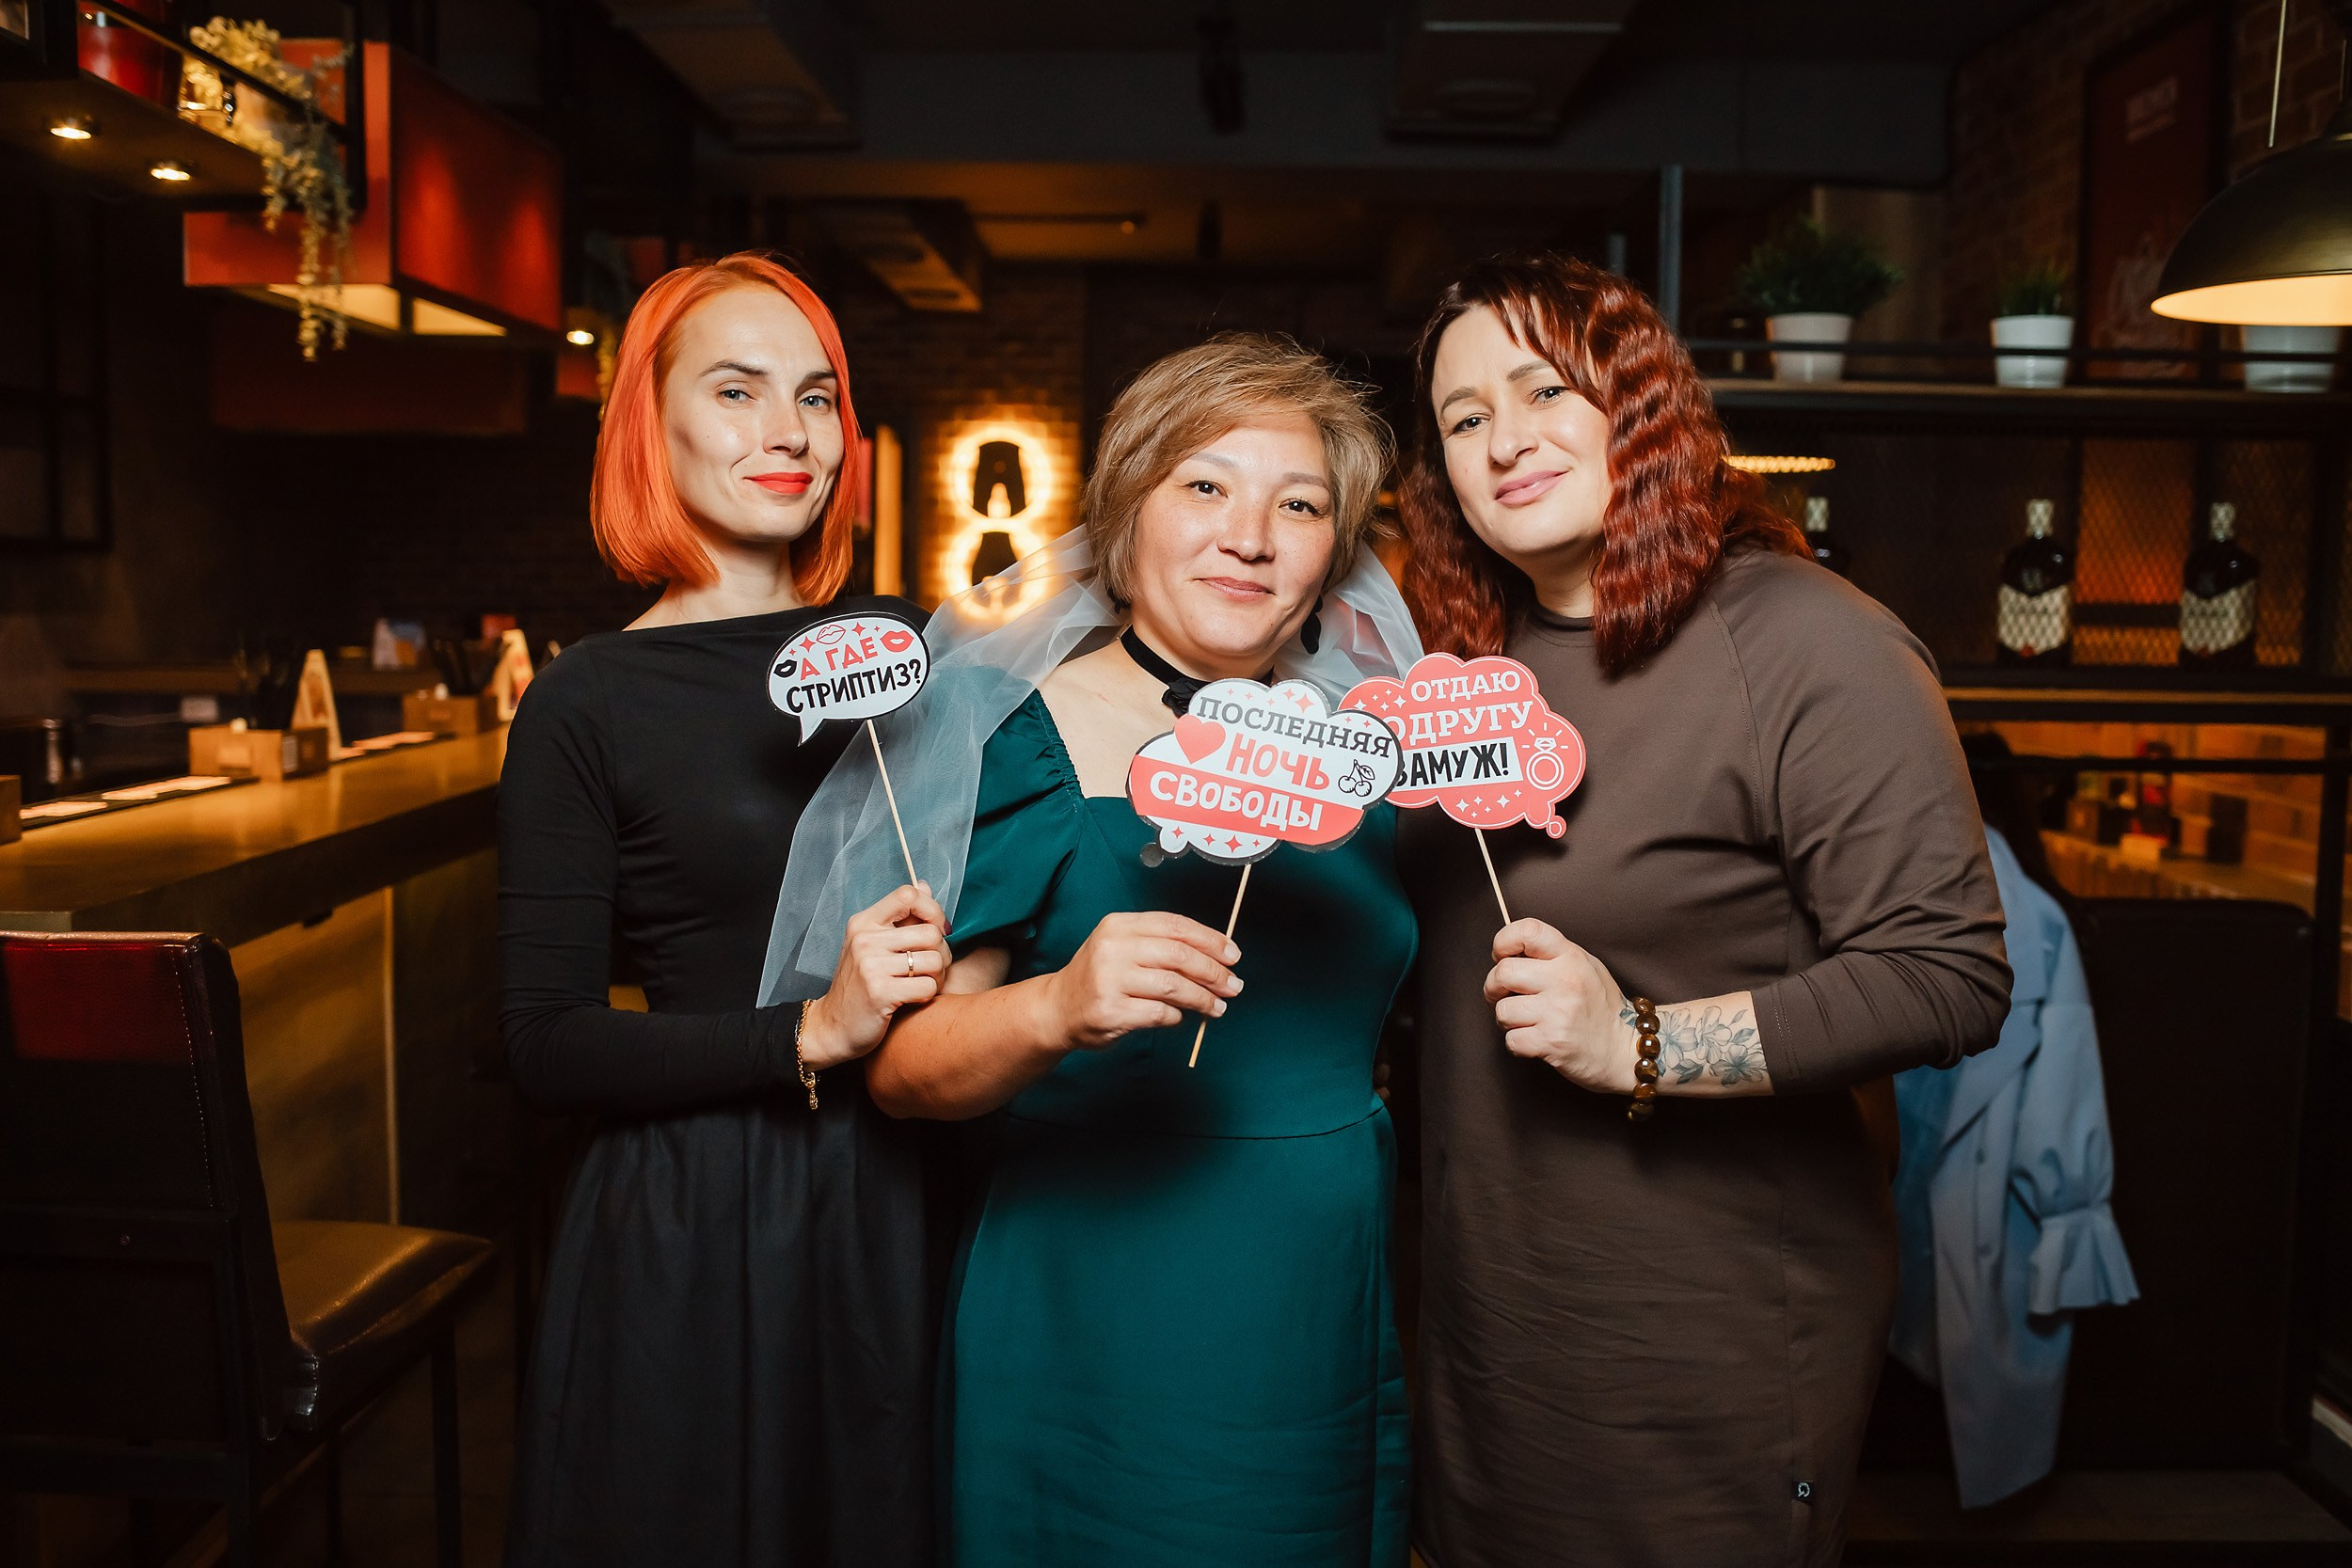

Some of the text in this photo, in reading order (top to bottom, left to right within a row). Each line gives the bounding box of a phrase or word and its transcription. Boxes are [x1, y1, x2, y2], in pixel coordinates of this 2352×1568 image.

[787, 658, 922, 713] СТРИПТИЗ?
[800, 637, 879, 681] А ГДЕ
[1411, 671, 1521, 702] ОТДАЮ
[1197, 696, 1392, 758] ПОСЛЕДНЯЯ
[1382, 700, 1534, 746] ОДРУГУ
[1225, 733, 1330, 790] НОЧЬ
[1150, 770, 1324, 832] СВОБОДЫ
